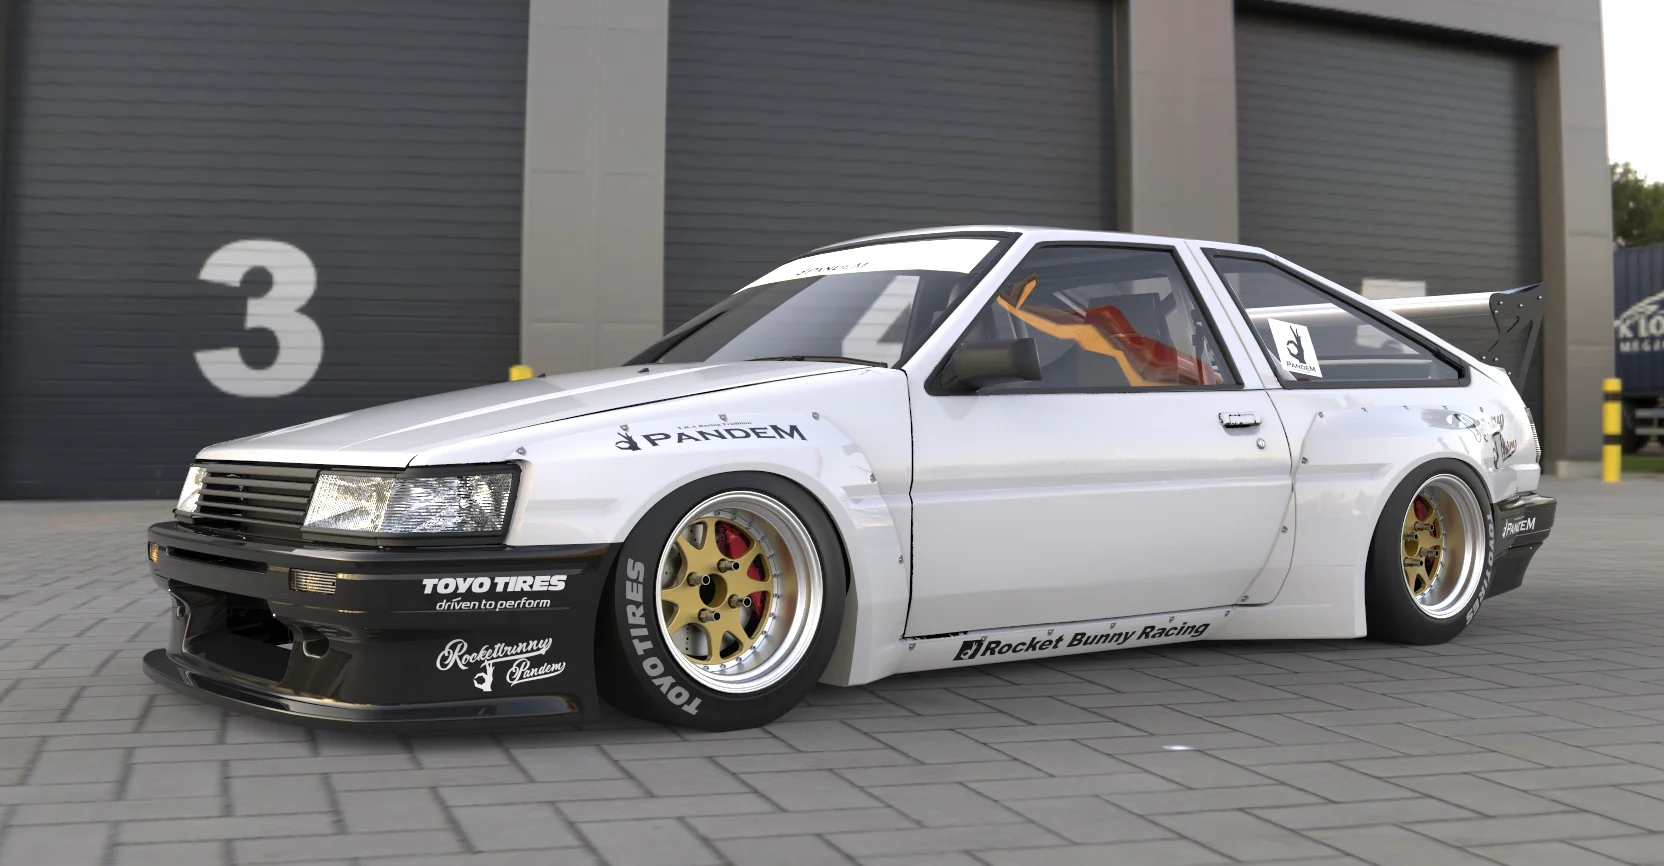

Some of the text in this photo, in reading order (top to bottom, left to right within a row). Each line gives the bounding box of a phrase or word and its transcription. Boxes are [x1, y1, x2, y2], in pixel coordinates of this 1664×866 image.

[194, 239, 324, 397] 3
[641, 424, 808, 447] PANDEM
[1465, 510, 1495, 626] TOYO TIRES
[422, 575, 567, 594] TOYO TIRES
[436, 597, 551, 611] driven to perform
[625, 558, 702, 716] TOYO TIRES
[980, 622, 1211, 657] Rocket Bunny Racing
[506, 658, 566, 687] Pandem
